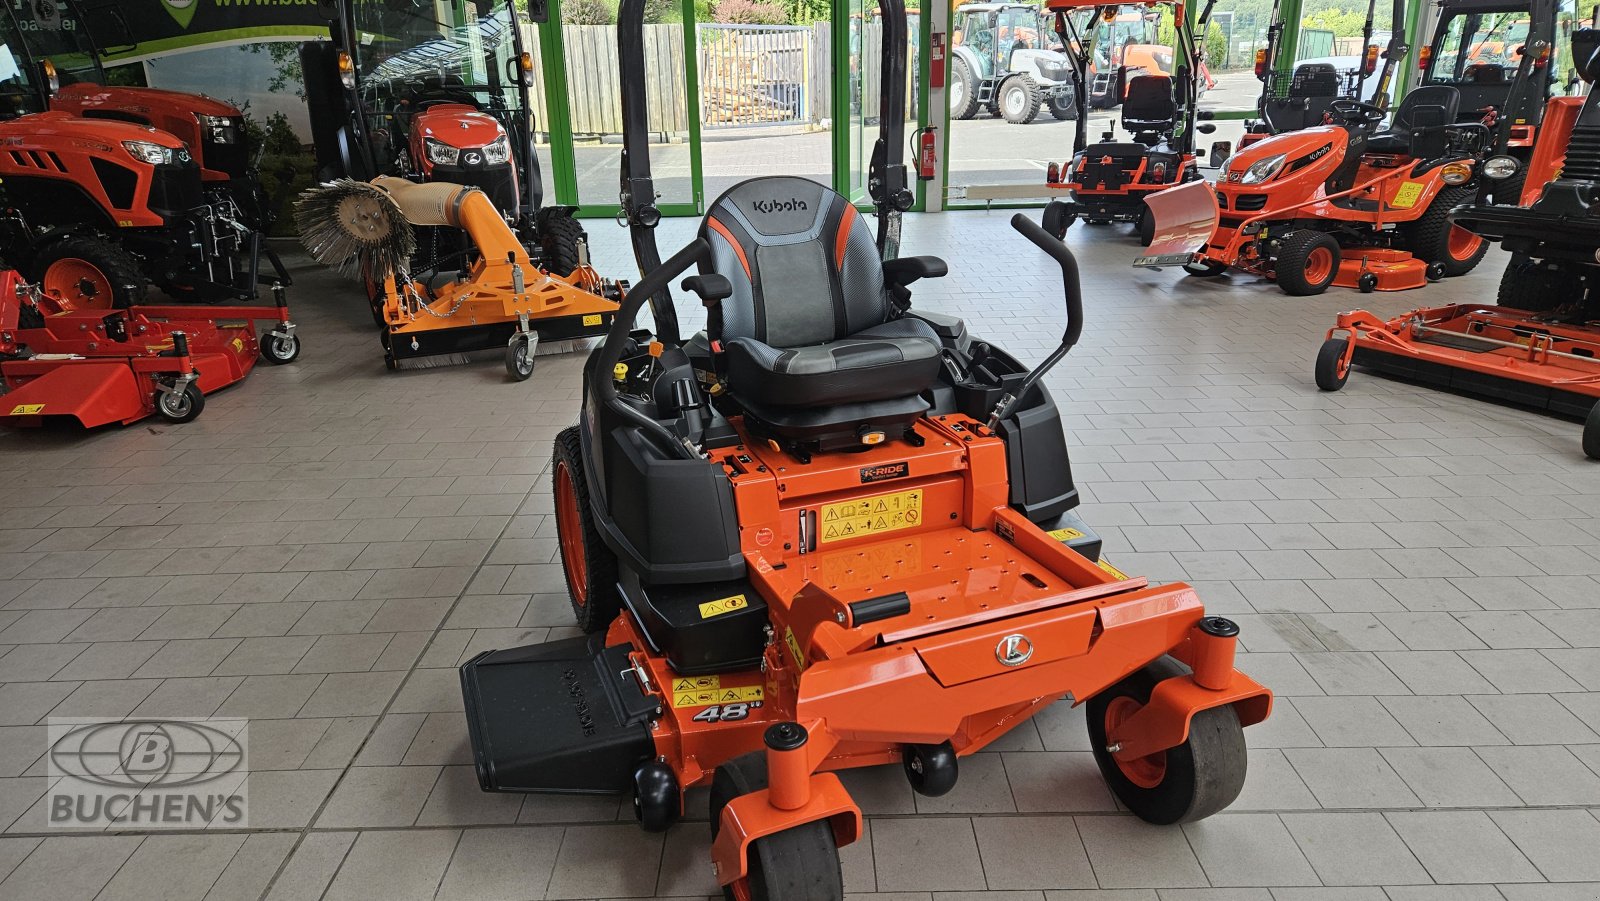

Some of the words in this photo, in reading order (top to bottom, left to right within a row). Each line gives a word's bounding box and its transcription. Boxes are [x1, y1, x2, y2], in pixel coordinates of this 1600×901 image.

[1309, 146, 1330, 160] Kubota
[752, 197, 808, 214] Kubota
[864, 464, 904, 477] K-RIDE
